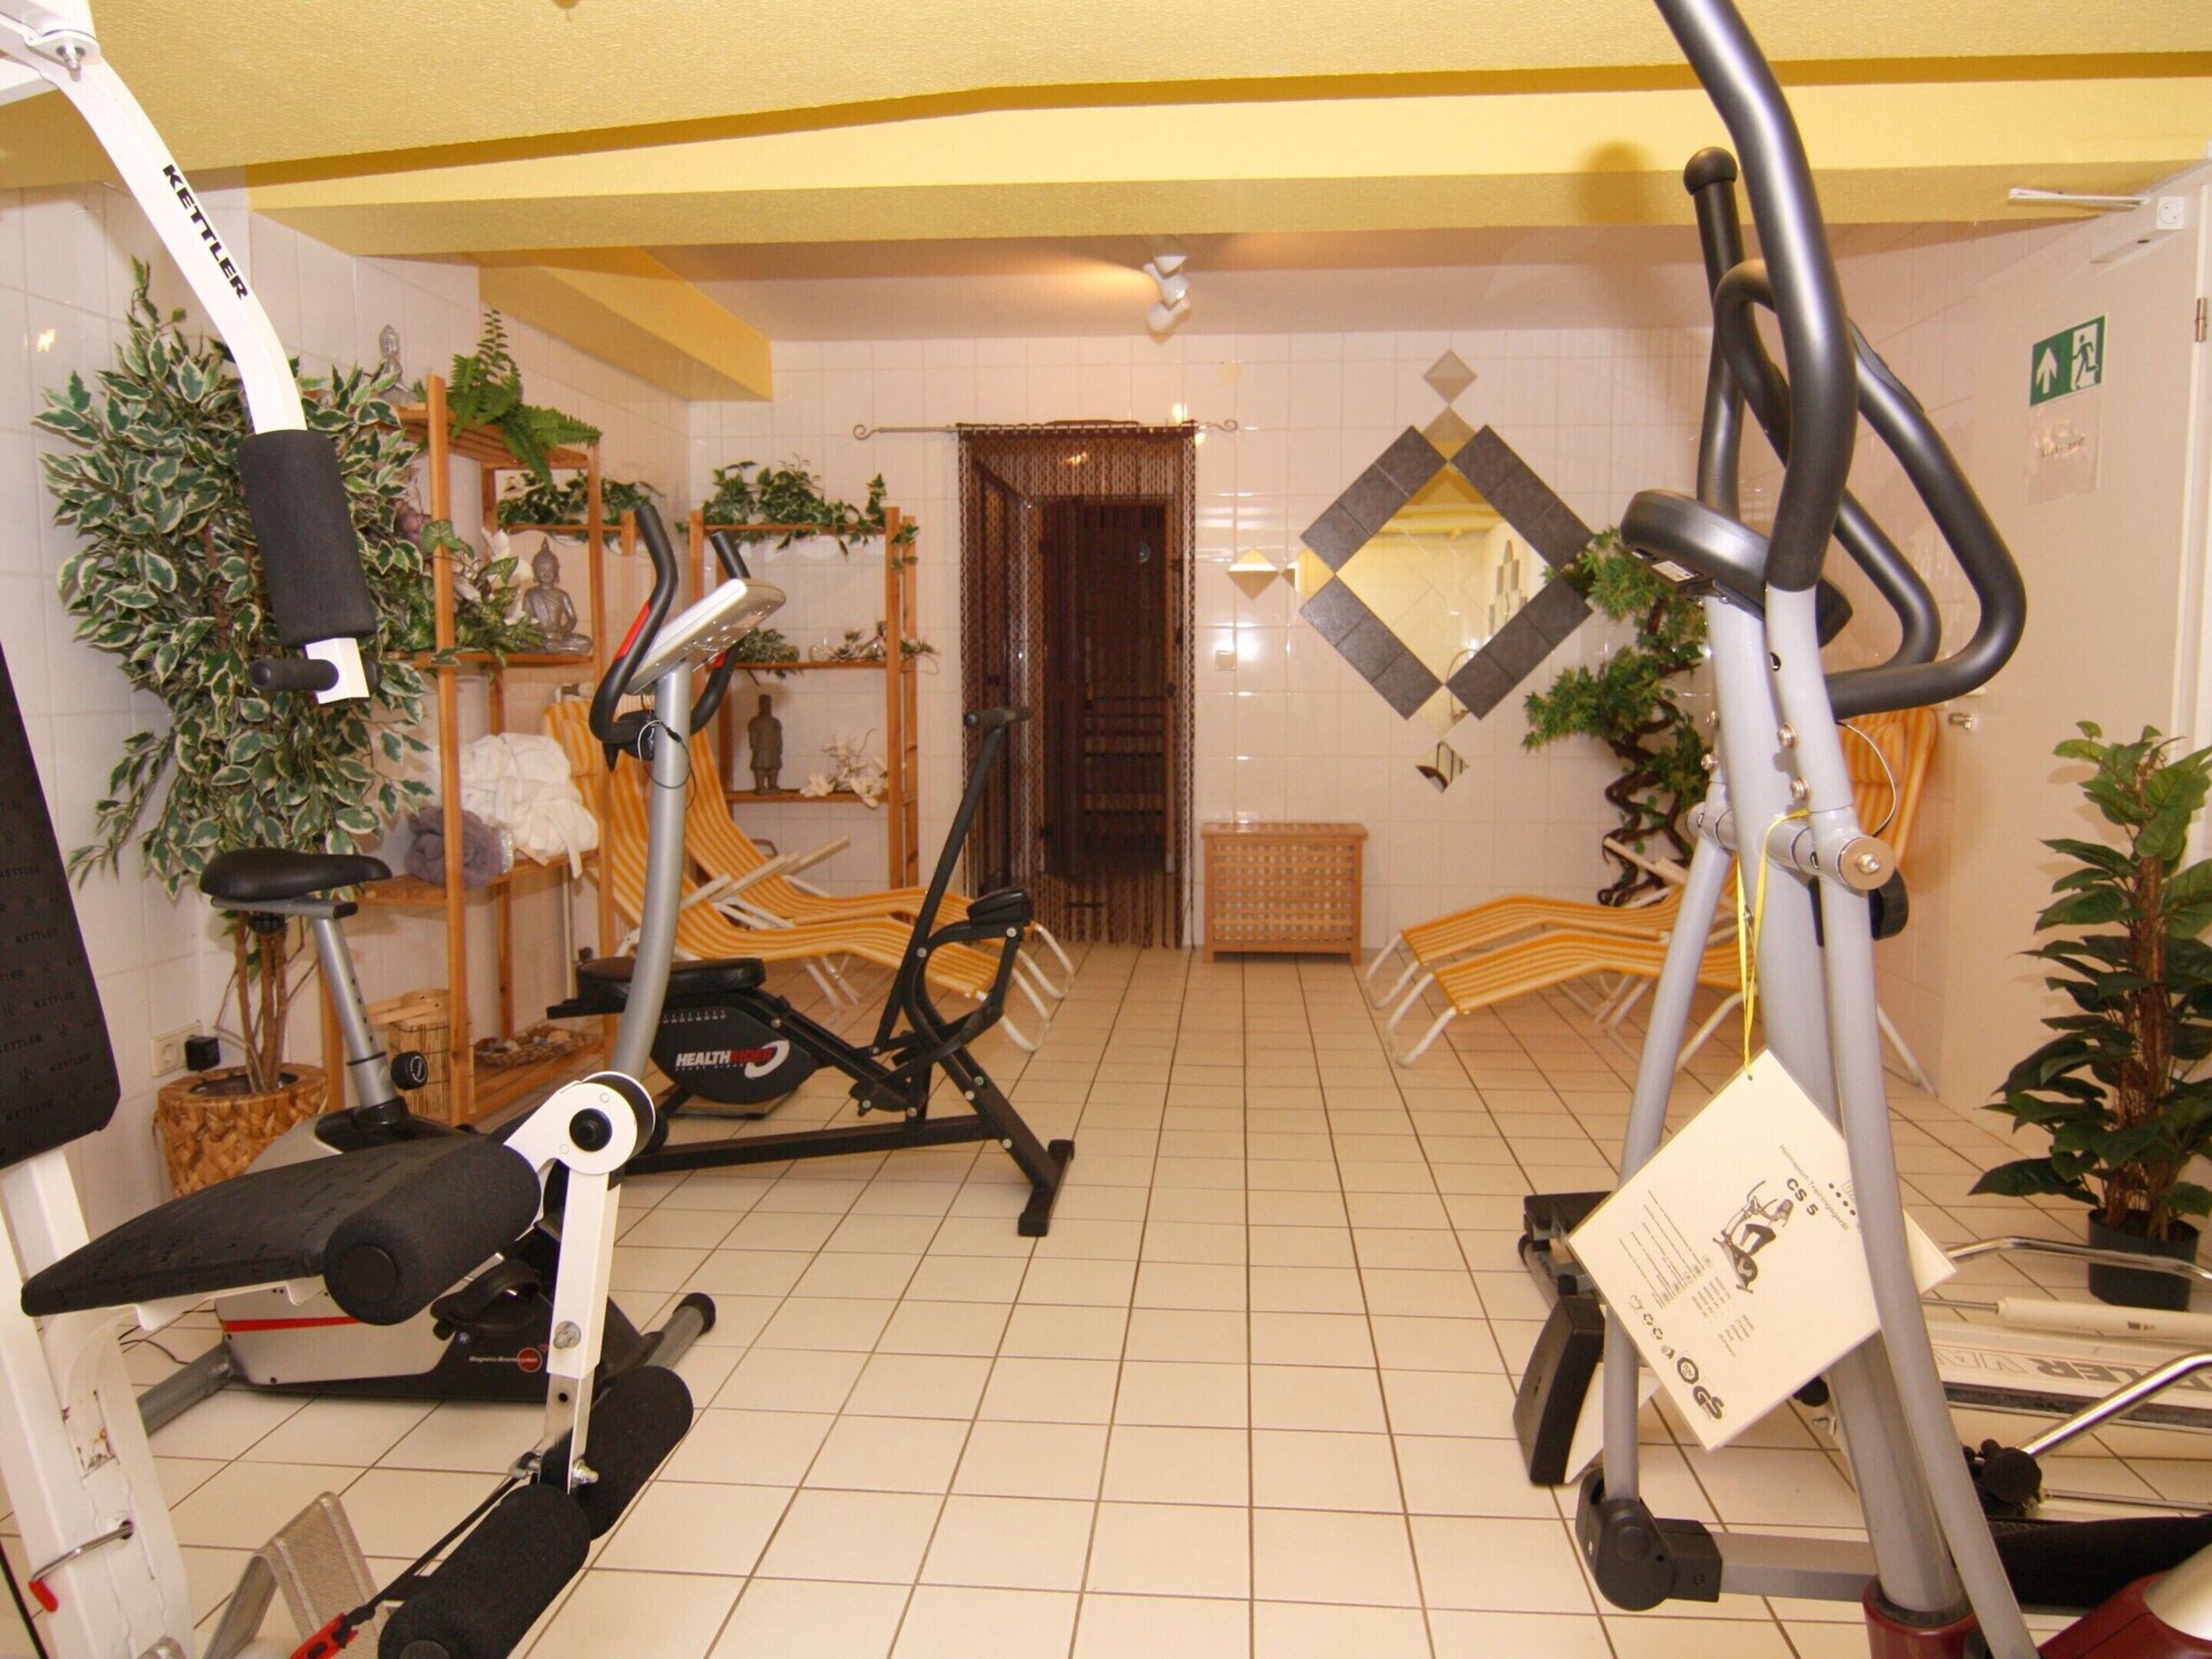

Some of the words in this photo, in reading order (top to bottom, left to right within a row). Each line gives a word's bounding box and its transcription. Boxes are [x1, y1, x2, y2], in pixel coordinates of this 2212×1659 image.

[163, 164, 248, 300] KETTLER
[1786, 1177, 1807, 1202] CS
[1806, 1204, 1819, 1216] 5
